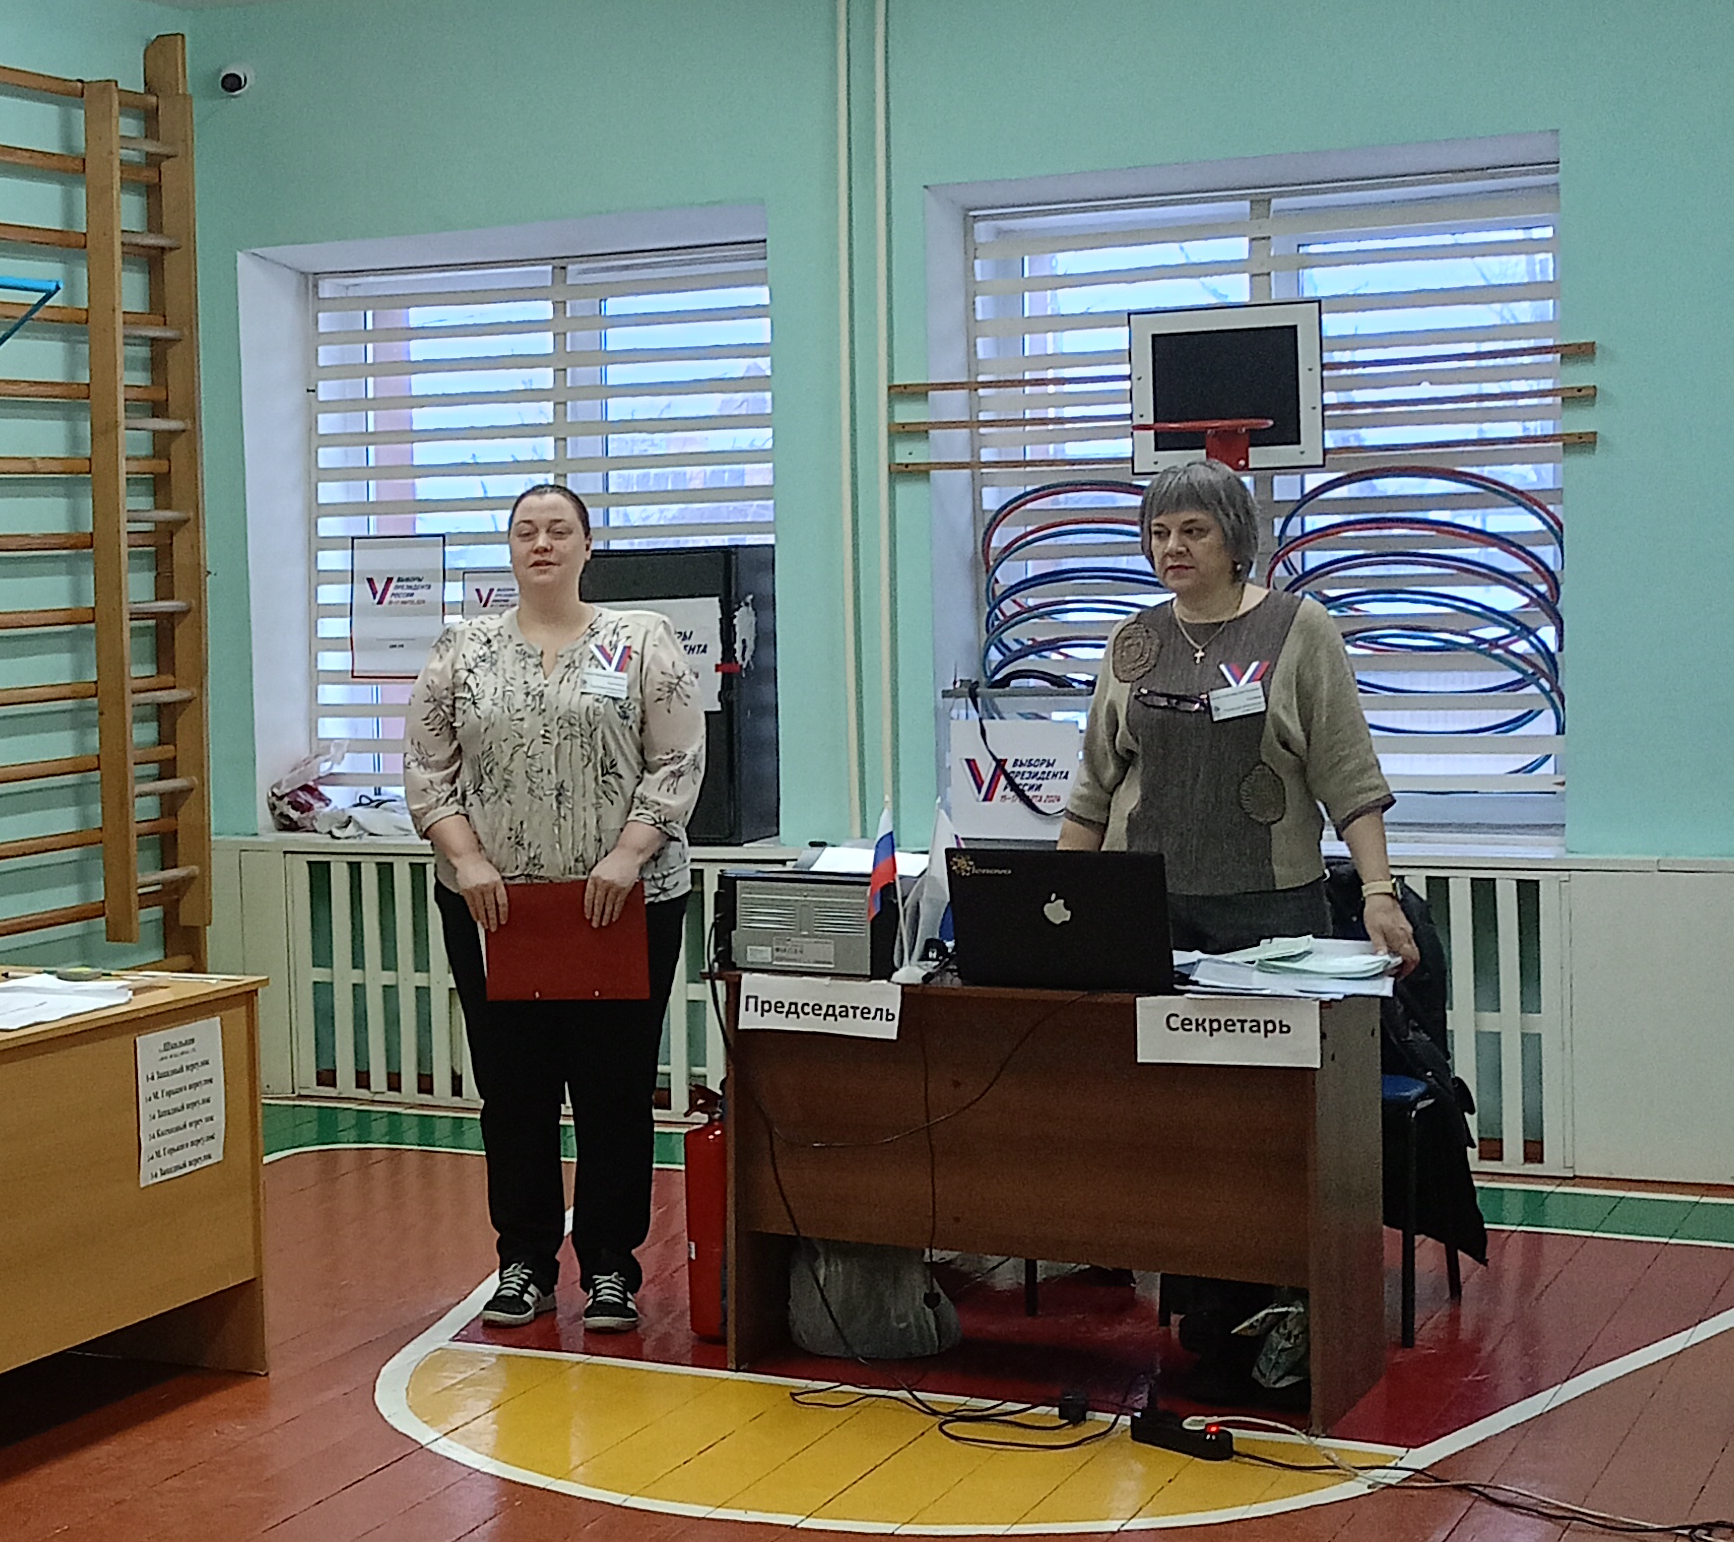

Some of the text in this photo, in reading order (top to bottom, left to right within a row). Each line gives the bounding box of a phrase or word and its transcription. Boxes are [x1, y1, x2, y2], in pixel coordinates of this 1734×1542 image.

[1012, 758, 1056, 768] ВЫБОРЫ
[745, 994, 896, 1023] Председатель
[1166, 1013, 1291, 1038] Секретарь
